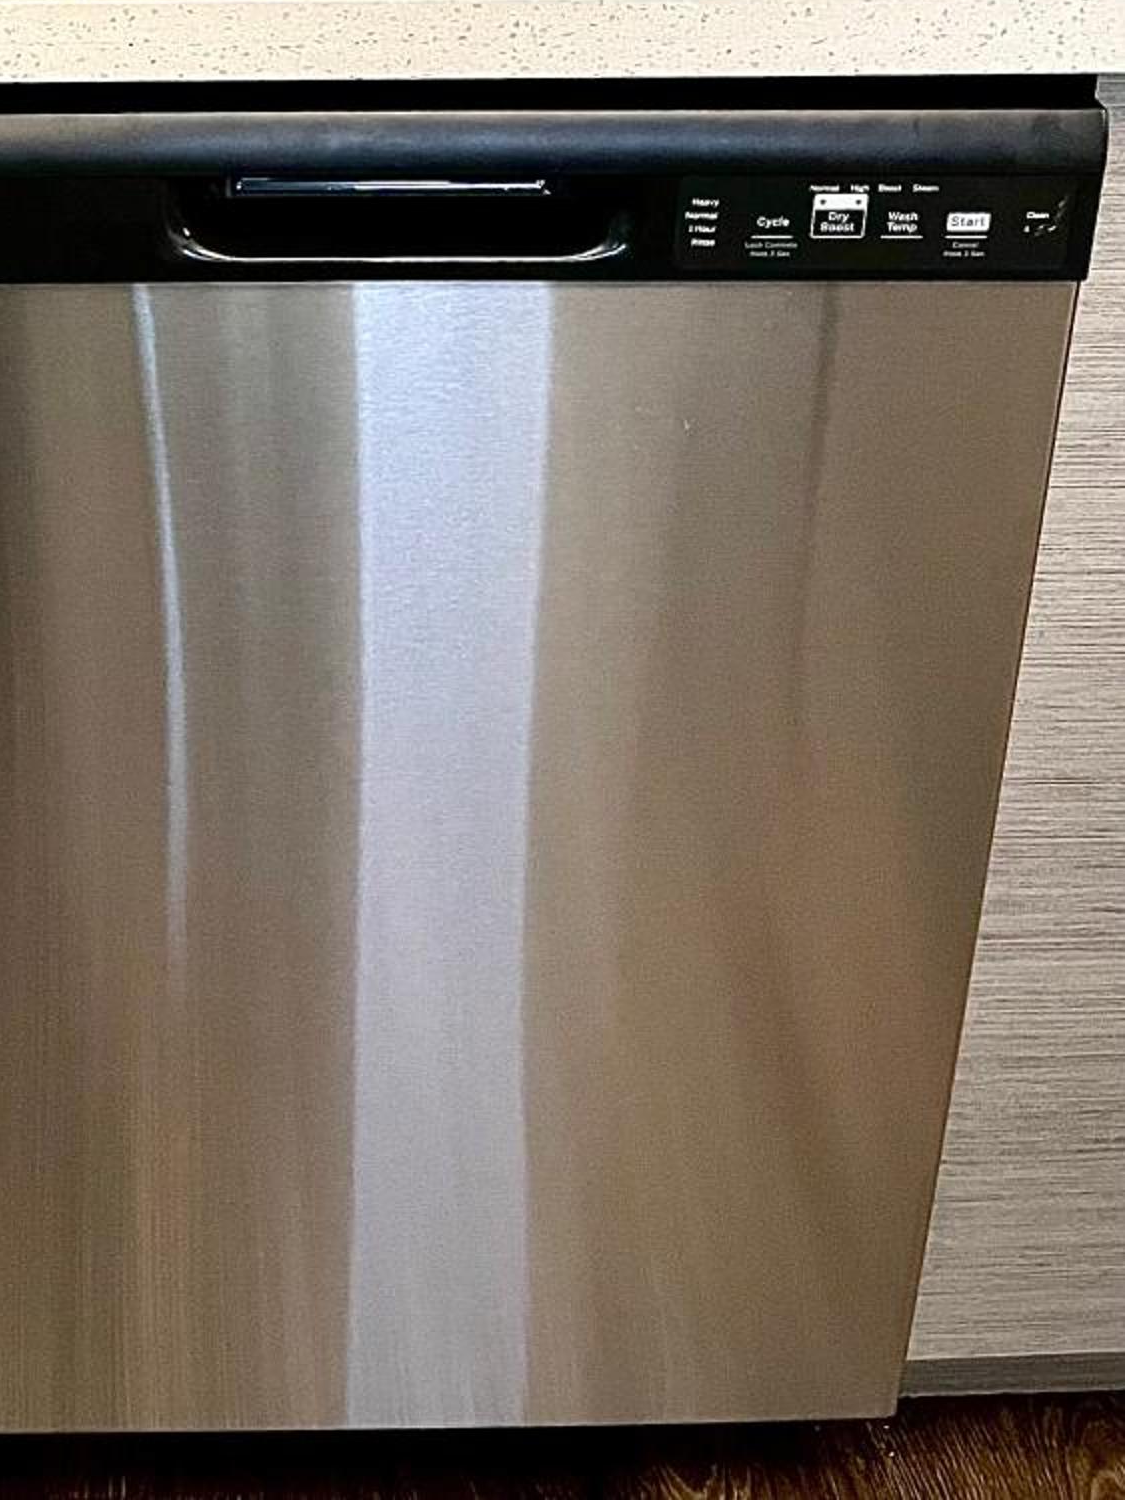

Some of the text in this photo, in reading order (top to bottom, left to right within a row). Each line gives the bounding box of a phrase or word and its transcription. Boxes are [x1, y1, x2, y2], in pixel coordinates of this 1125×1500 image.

[828, 211, 850, 223] Dry
[887, 211, 919, 221] Wash
[951, 216, 986, 227] Start
[756, 216, 790, 228] Cycle
[820, 221, 855, 232] Boost
[887, 221, 918, 233] Temp
